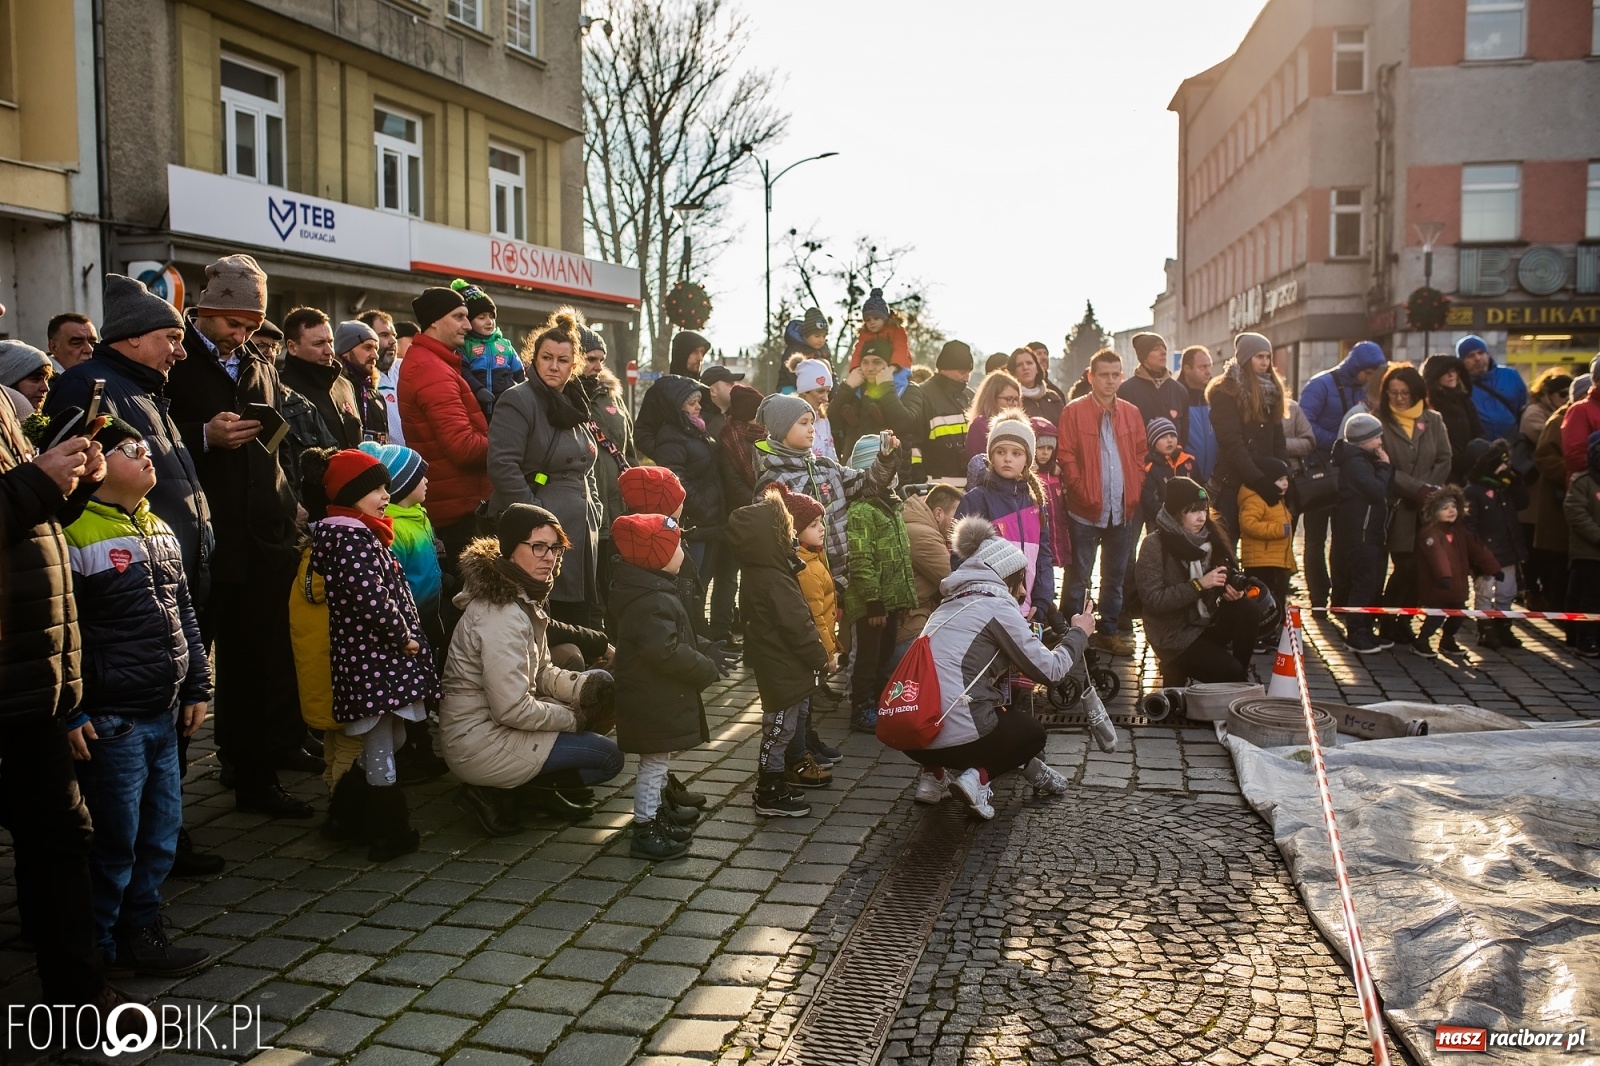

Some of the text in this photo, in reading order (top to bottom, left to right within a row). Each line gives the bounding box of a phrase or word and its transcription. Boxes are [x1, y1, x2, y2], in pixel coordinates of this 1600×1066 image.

[299, 203, 335, 230] TEB
[299, 229, 336, 243] EDUKACJA
[491, 240, 593, 286] ROSSMANN
[1486, 307, 1600, 325] DELIKAT
